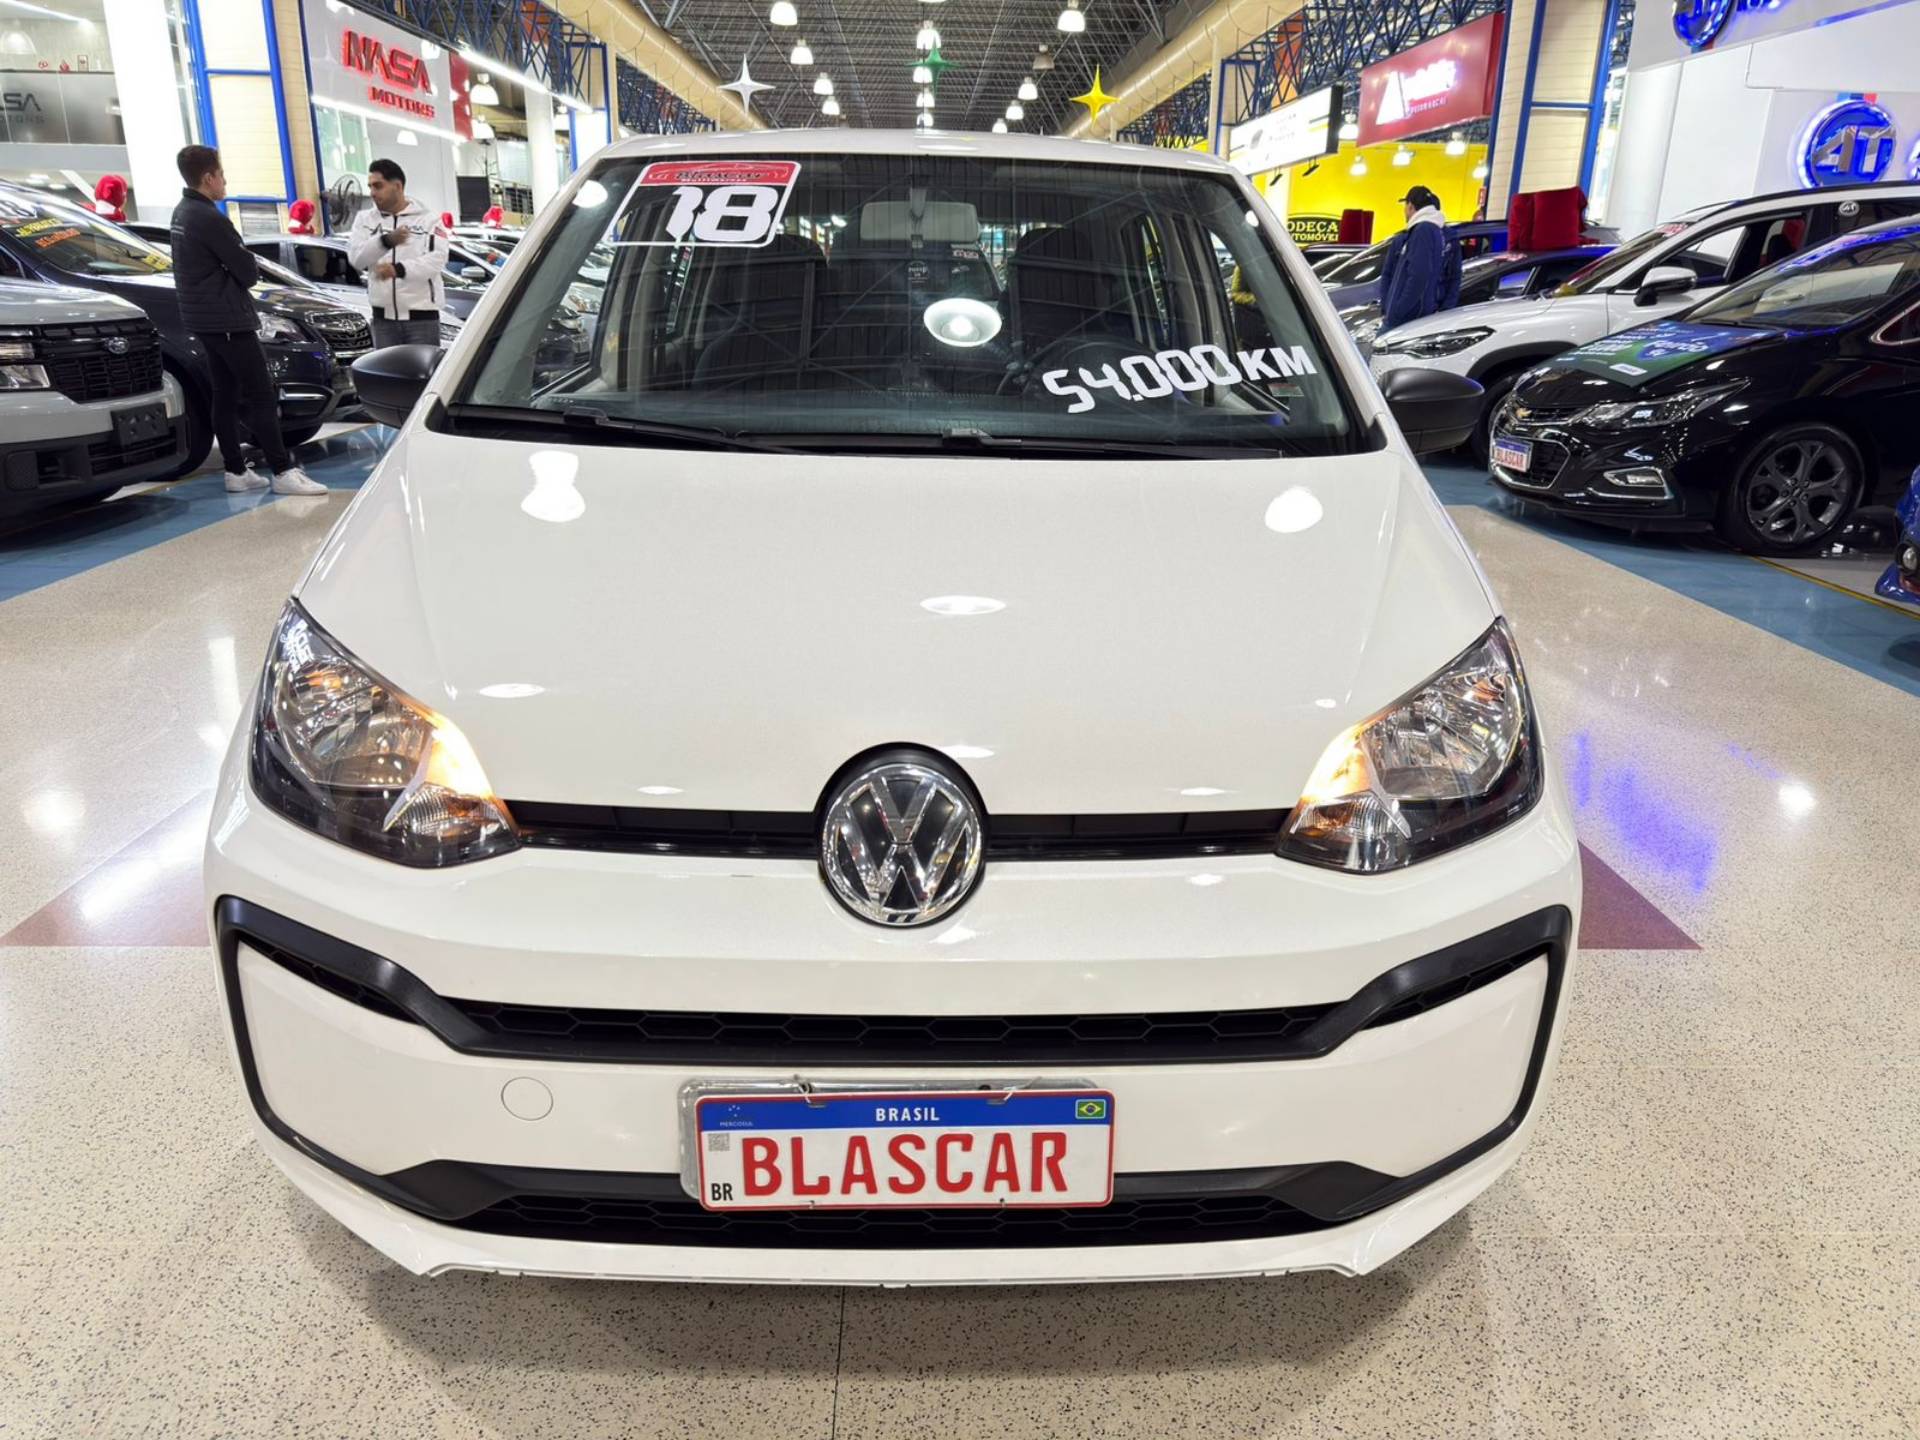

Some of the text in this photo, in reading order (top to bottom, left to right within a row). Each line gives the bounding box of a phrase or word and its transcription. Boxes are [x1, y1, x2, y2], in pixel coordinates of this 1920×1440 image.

[343, 29, 433, 96] NASA
[369, 86, 435, 119] MOTORS
[665, 185, 779, 242] 18
[1286, 221, 1339, 233] ODECA
[1042, 344, 1319, 414] 54.000 KM
[875, 1107, 940, 1122] BRASIL
[742, 1131, 1068, 1196] BLASCAR
[711, 1183, 733, 1201] BR
